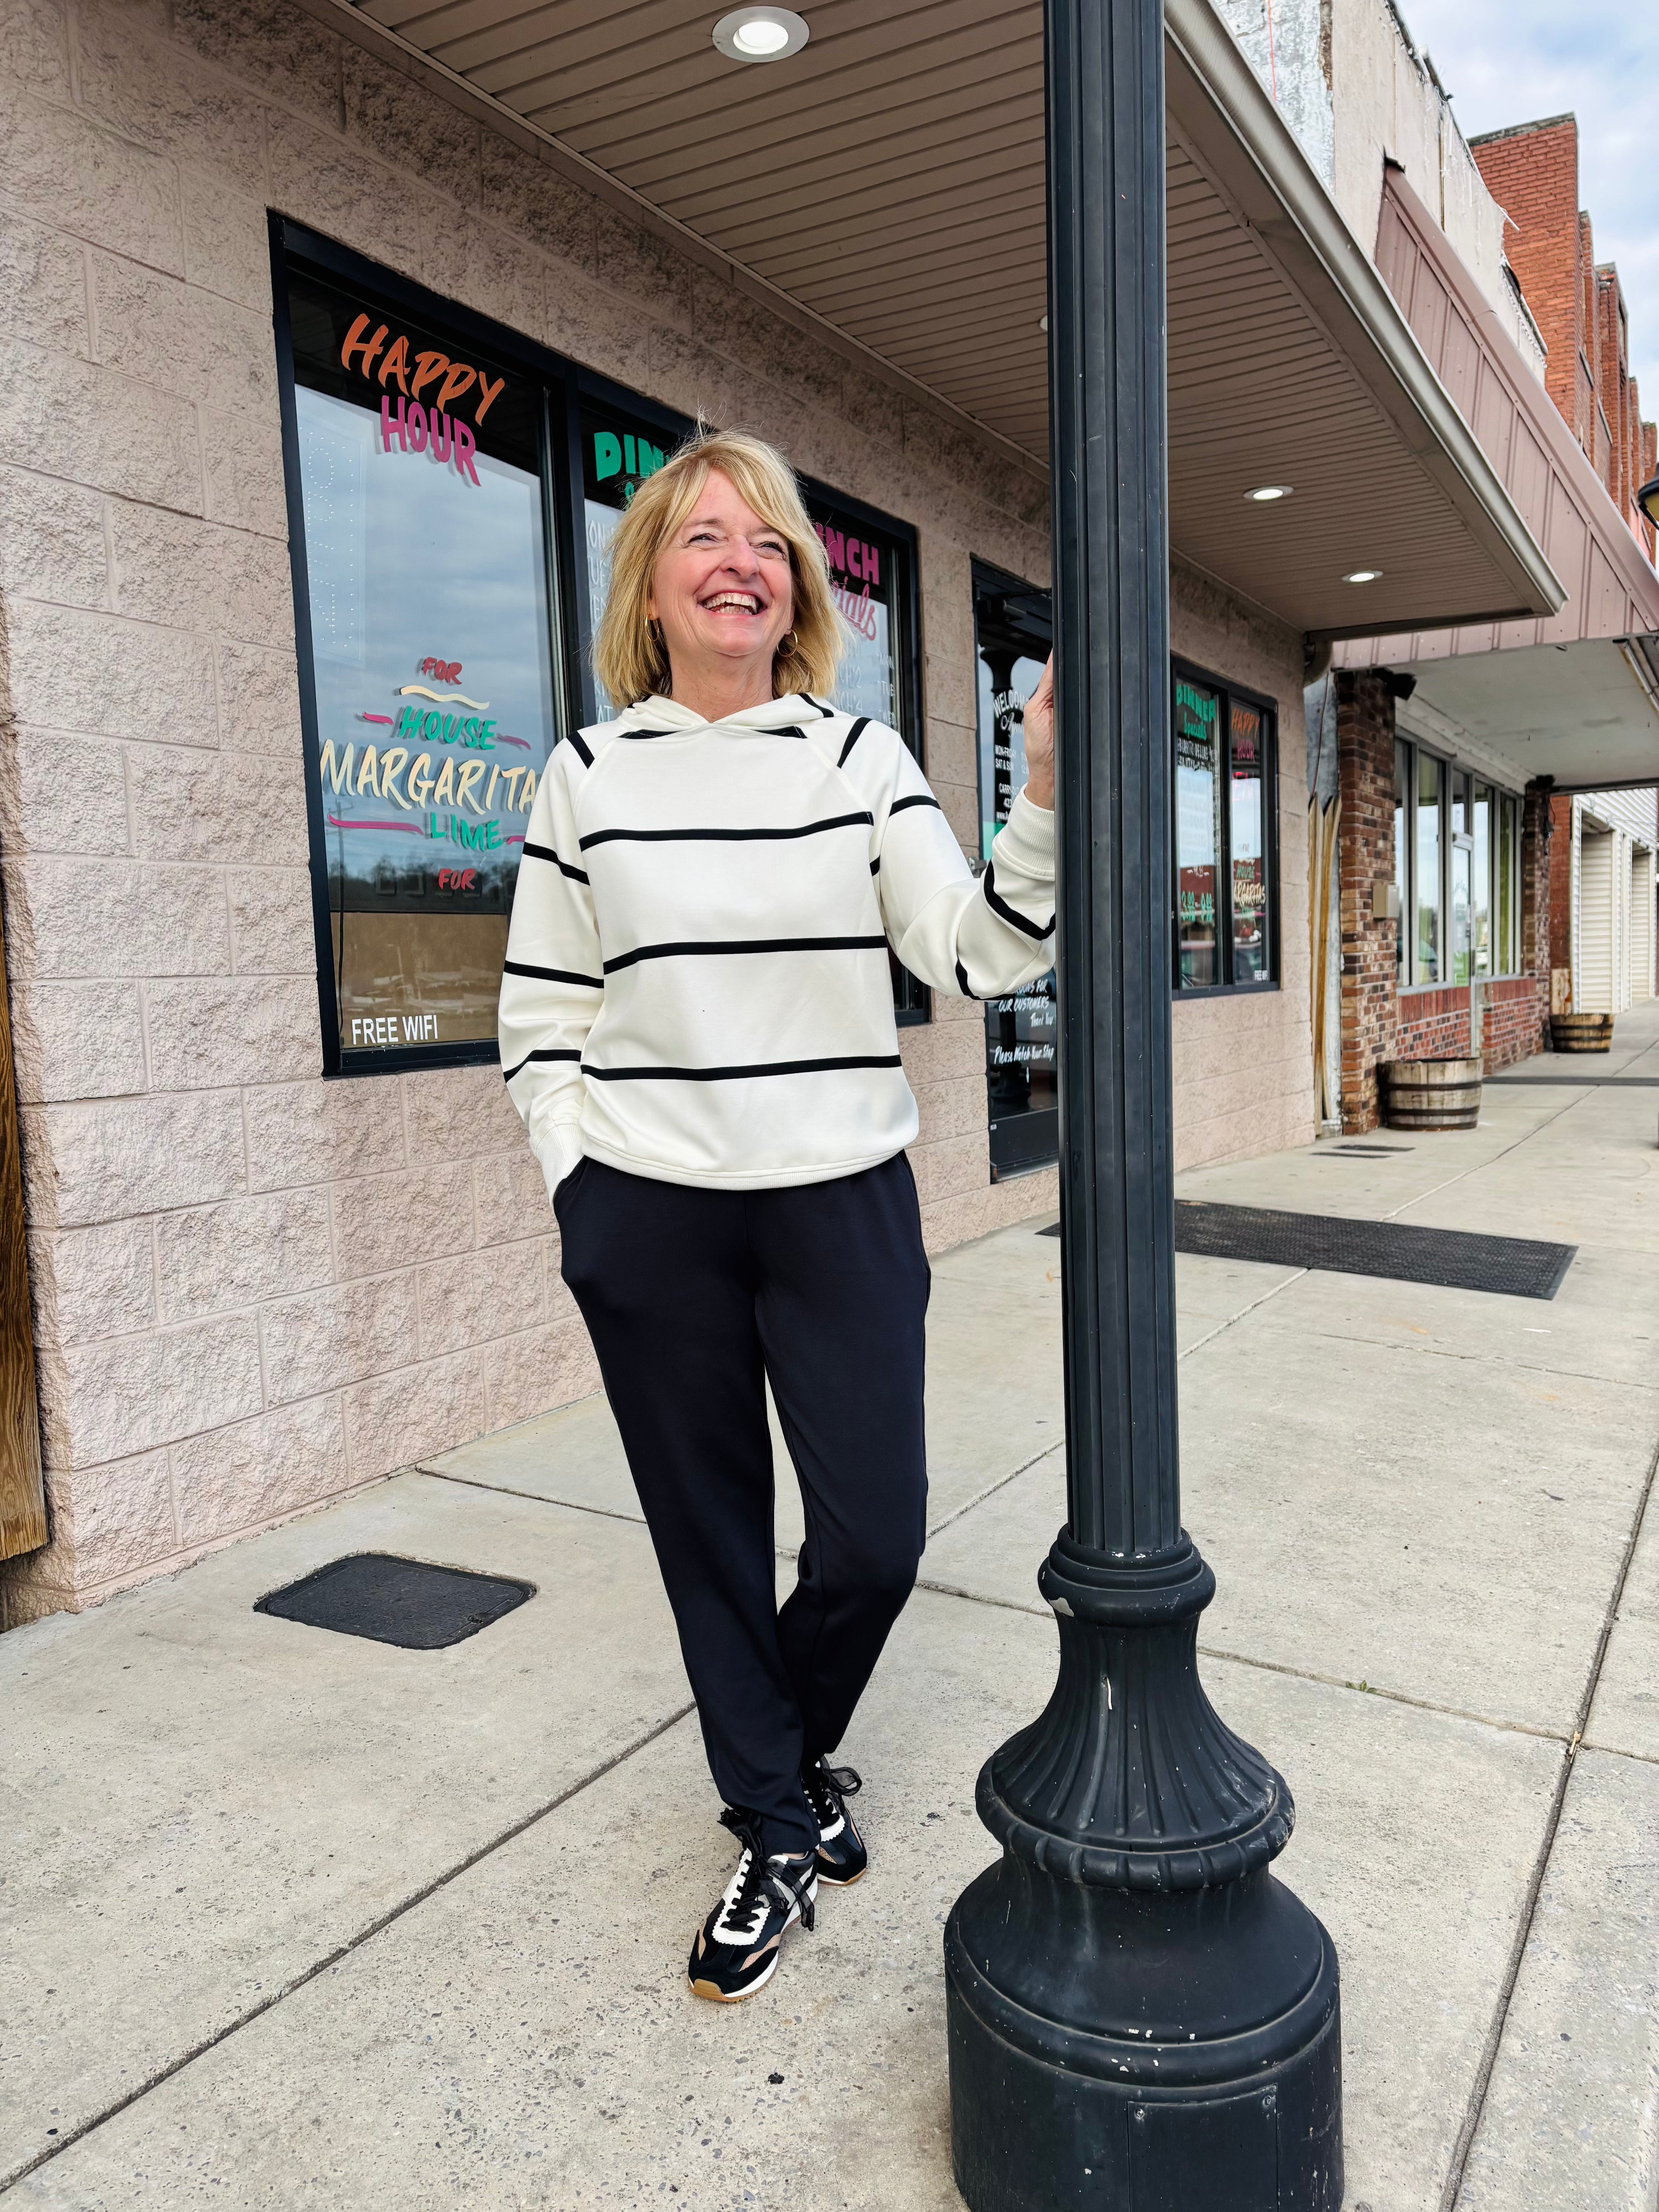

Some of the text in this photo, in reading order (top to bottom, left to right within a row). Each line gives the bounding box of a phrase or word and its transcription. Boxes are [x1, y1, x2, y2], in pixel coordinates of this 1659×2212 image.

[341, 313, 505, 427] HAPPY
[381, 395, 482, 487] HOUR
[423, 657, 463, 685] FOR
[993, 690, 1027, 718] WELCOM
[1176, 684, 1215, 722] DINNER
[399, 706, 498, 750] HOUSE
[1230, 706, 1260, 740] HAPPY
[430, 812, 503, 852] LIME
[439, 868, 475, 890] FOR
[1233, 881, 1266, 907] ARGARITAS
[998, 996, 1049, 1013] OUR CUSTOMERS
[352, 1014, 438, 1045] FREE WIFI
[994, 1045, 1013, 1065] Please
[1043, 1043, 1054, 1062] Step
